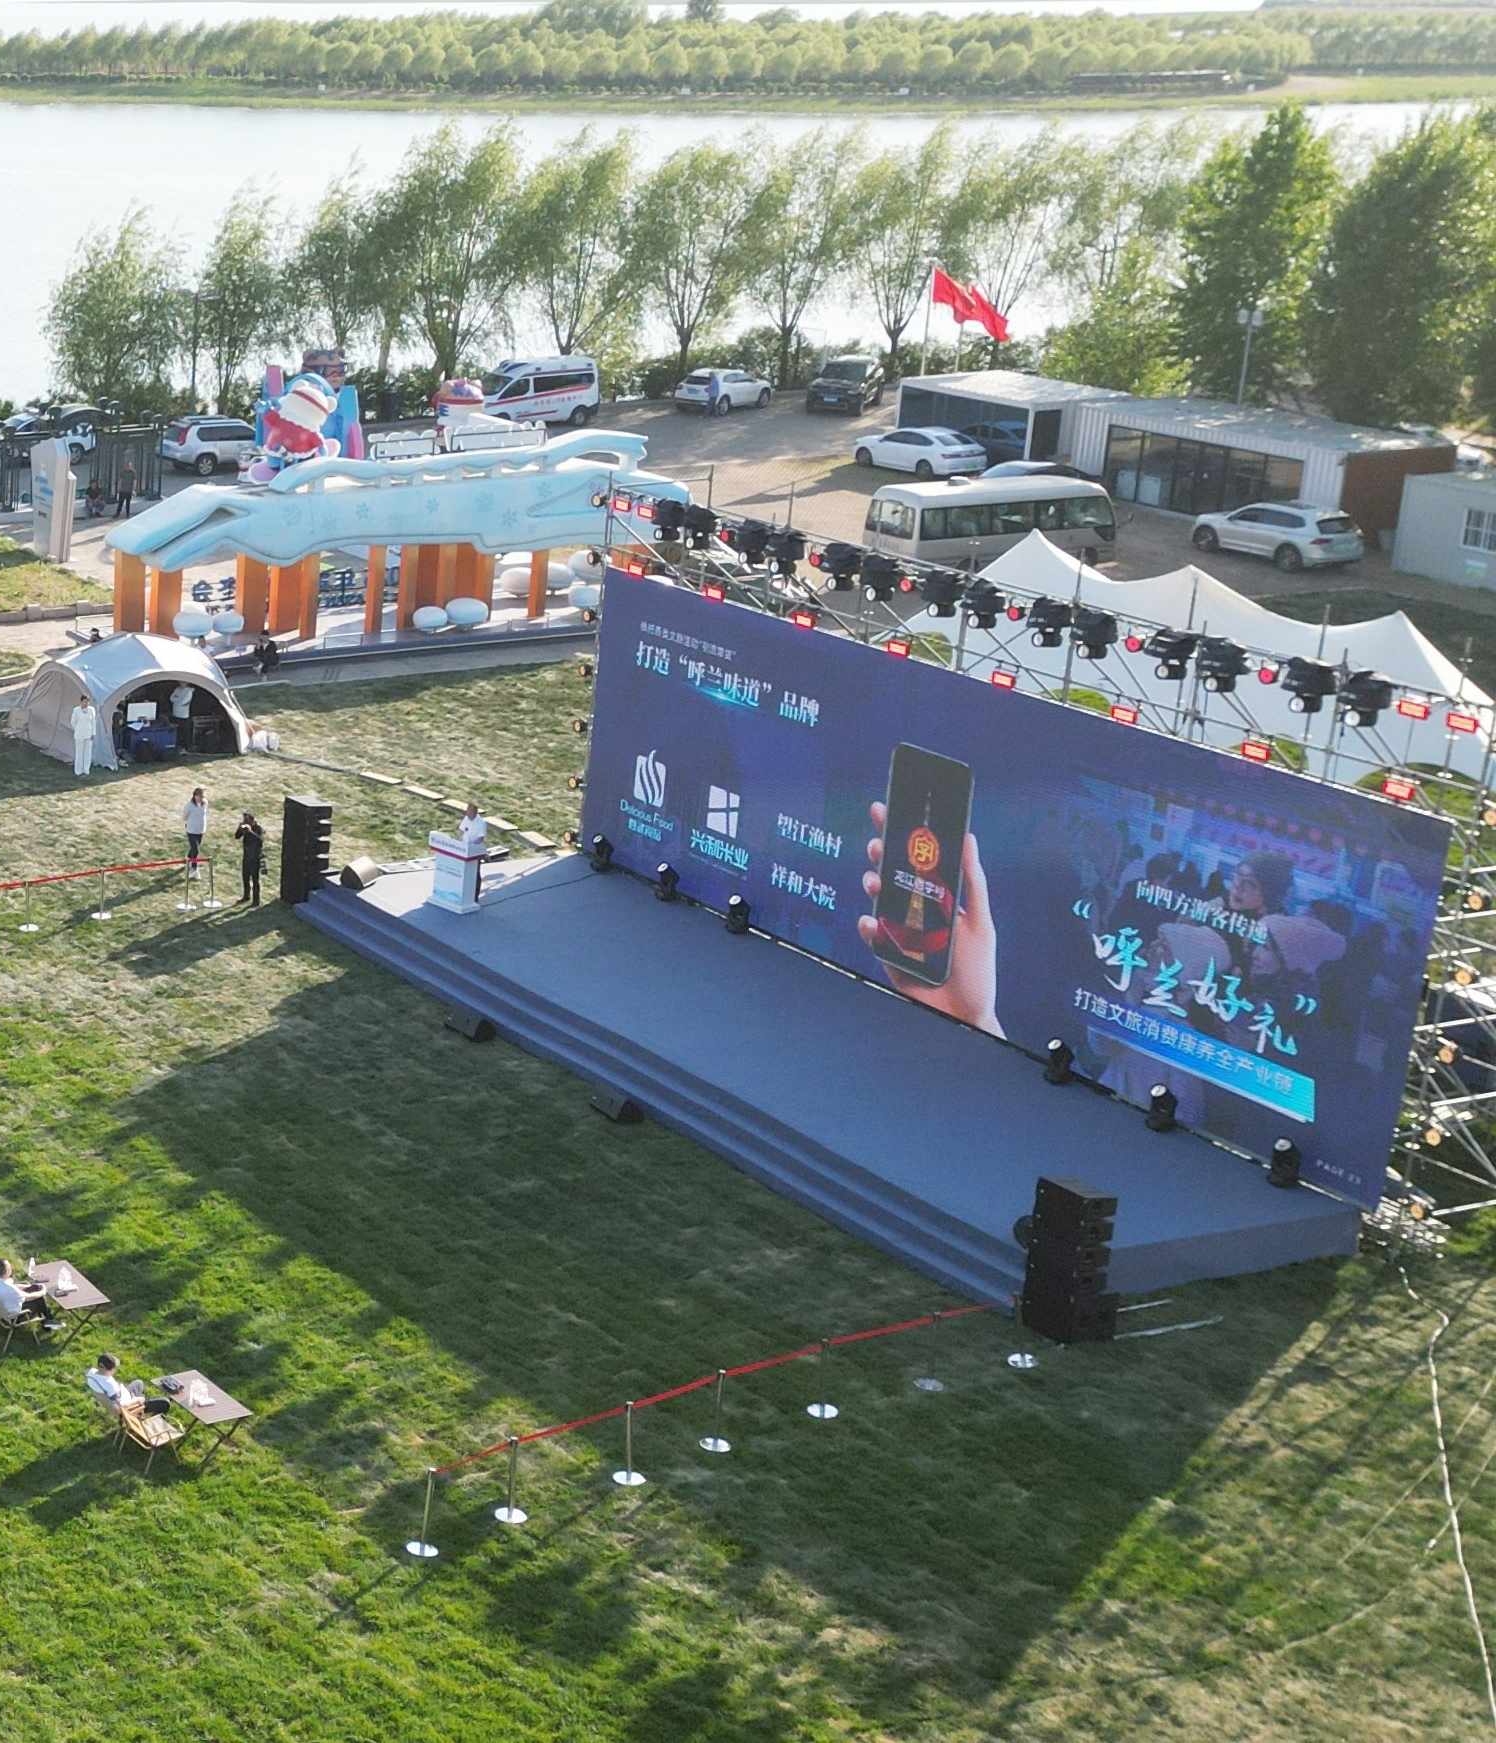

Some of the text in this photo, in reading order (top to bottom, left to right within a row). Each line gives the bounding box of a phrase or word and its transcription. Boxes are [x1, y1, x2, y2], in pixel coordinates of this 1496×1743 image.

[777, 813, 843, 858] 望江渔村
[771, 862, 837, 910] 祥和大院
[1136, 880, 1270, 945] 向四方游客传递
[1073, 987, 1294, 1095] 打造文旅消费康养全产业链
